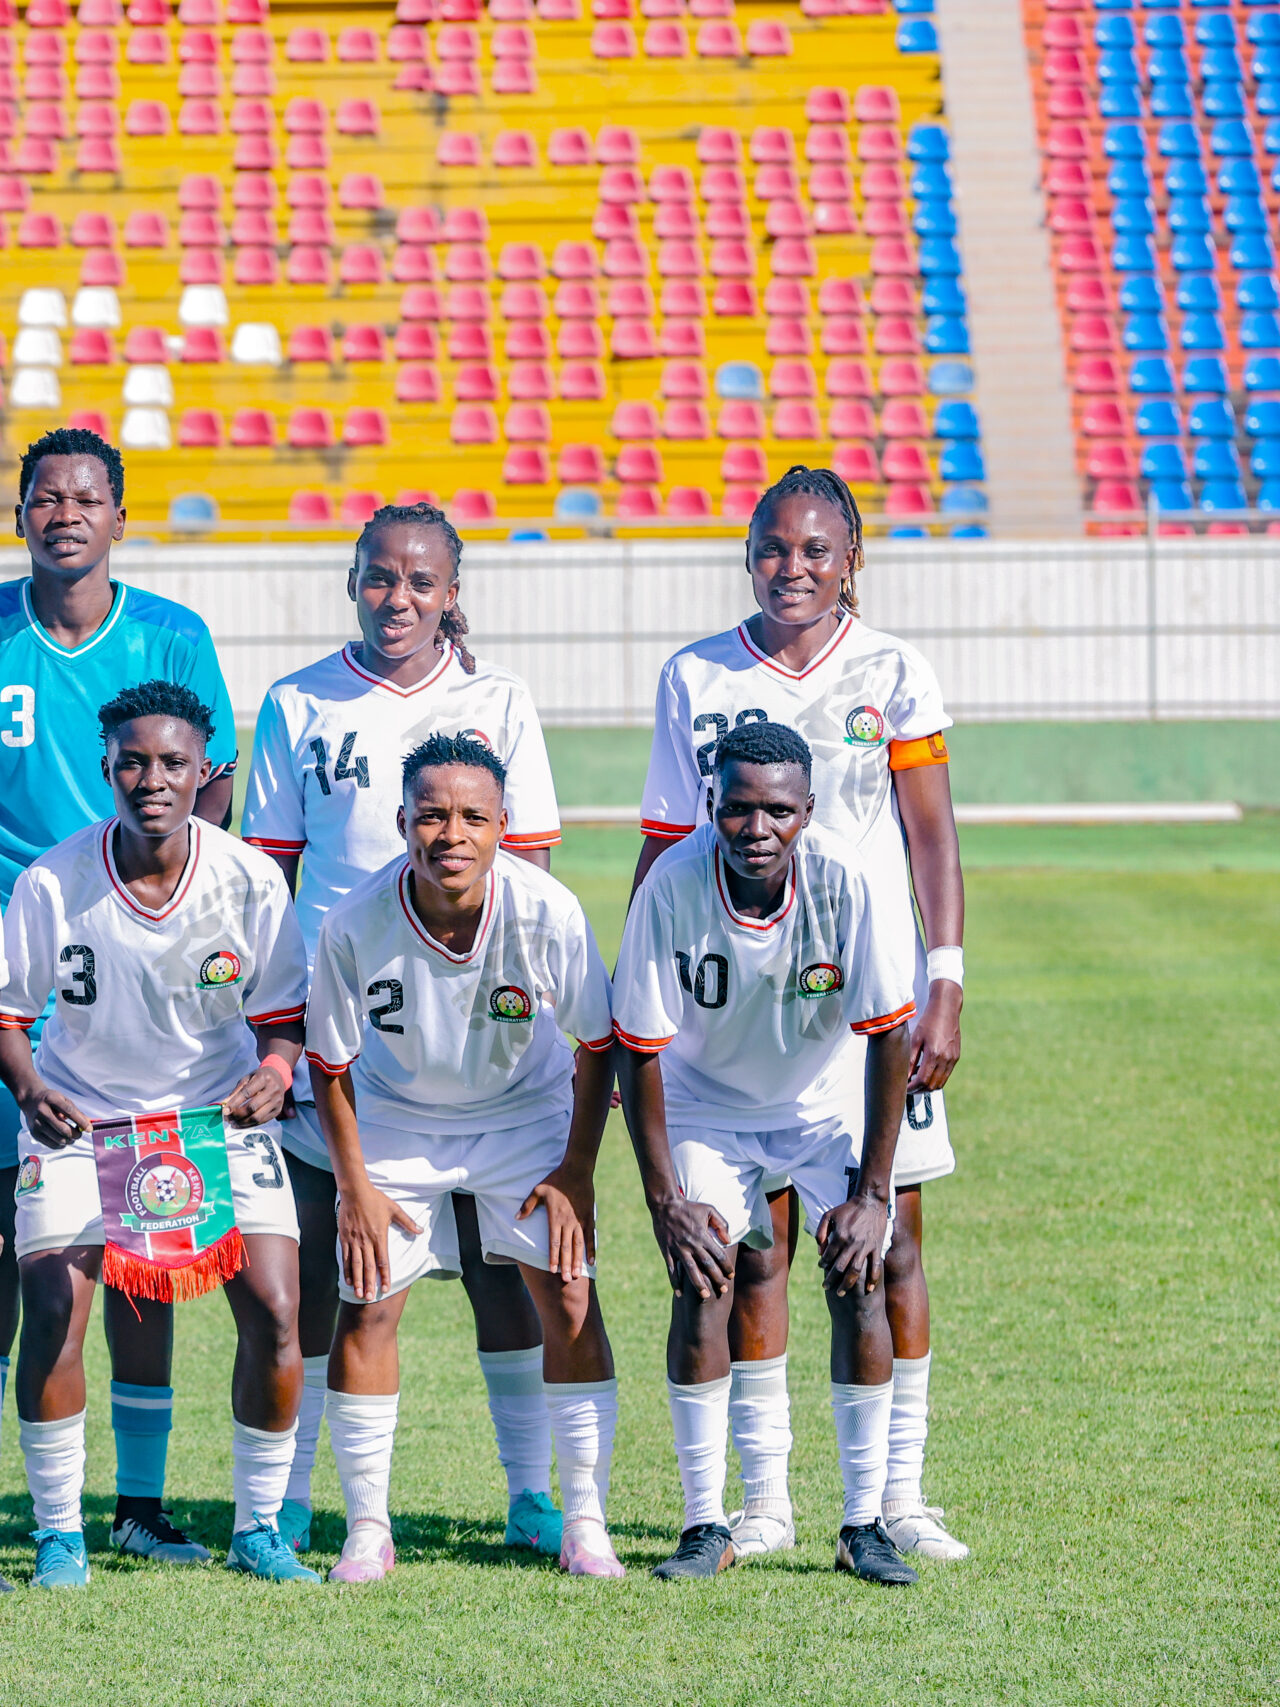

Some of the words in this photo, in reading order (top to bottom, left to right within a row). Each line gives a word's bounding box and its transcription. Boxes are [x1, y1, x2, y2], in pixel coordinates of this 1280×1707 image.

[309, 731, 370, 796] 14
[694, 708, 768, 777] 2
[59, 944, 97, 1006] 3
[674, 950, 729, 1010] 10
[367, 978, 405, 1036] 2
[104, 1124, 214, 1150] KENYA
[242, 1132, 284, 1189] 3
[130, 1165, 150, 1217] FOOTBALL
[186, 1167, 202, 1204] KENYA
[140, 1213, 200, 1231] FEDERATION
